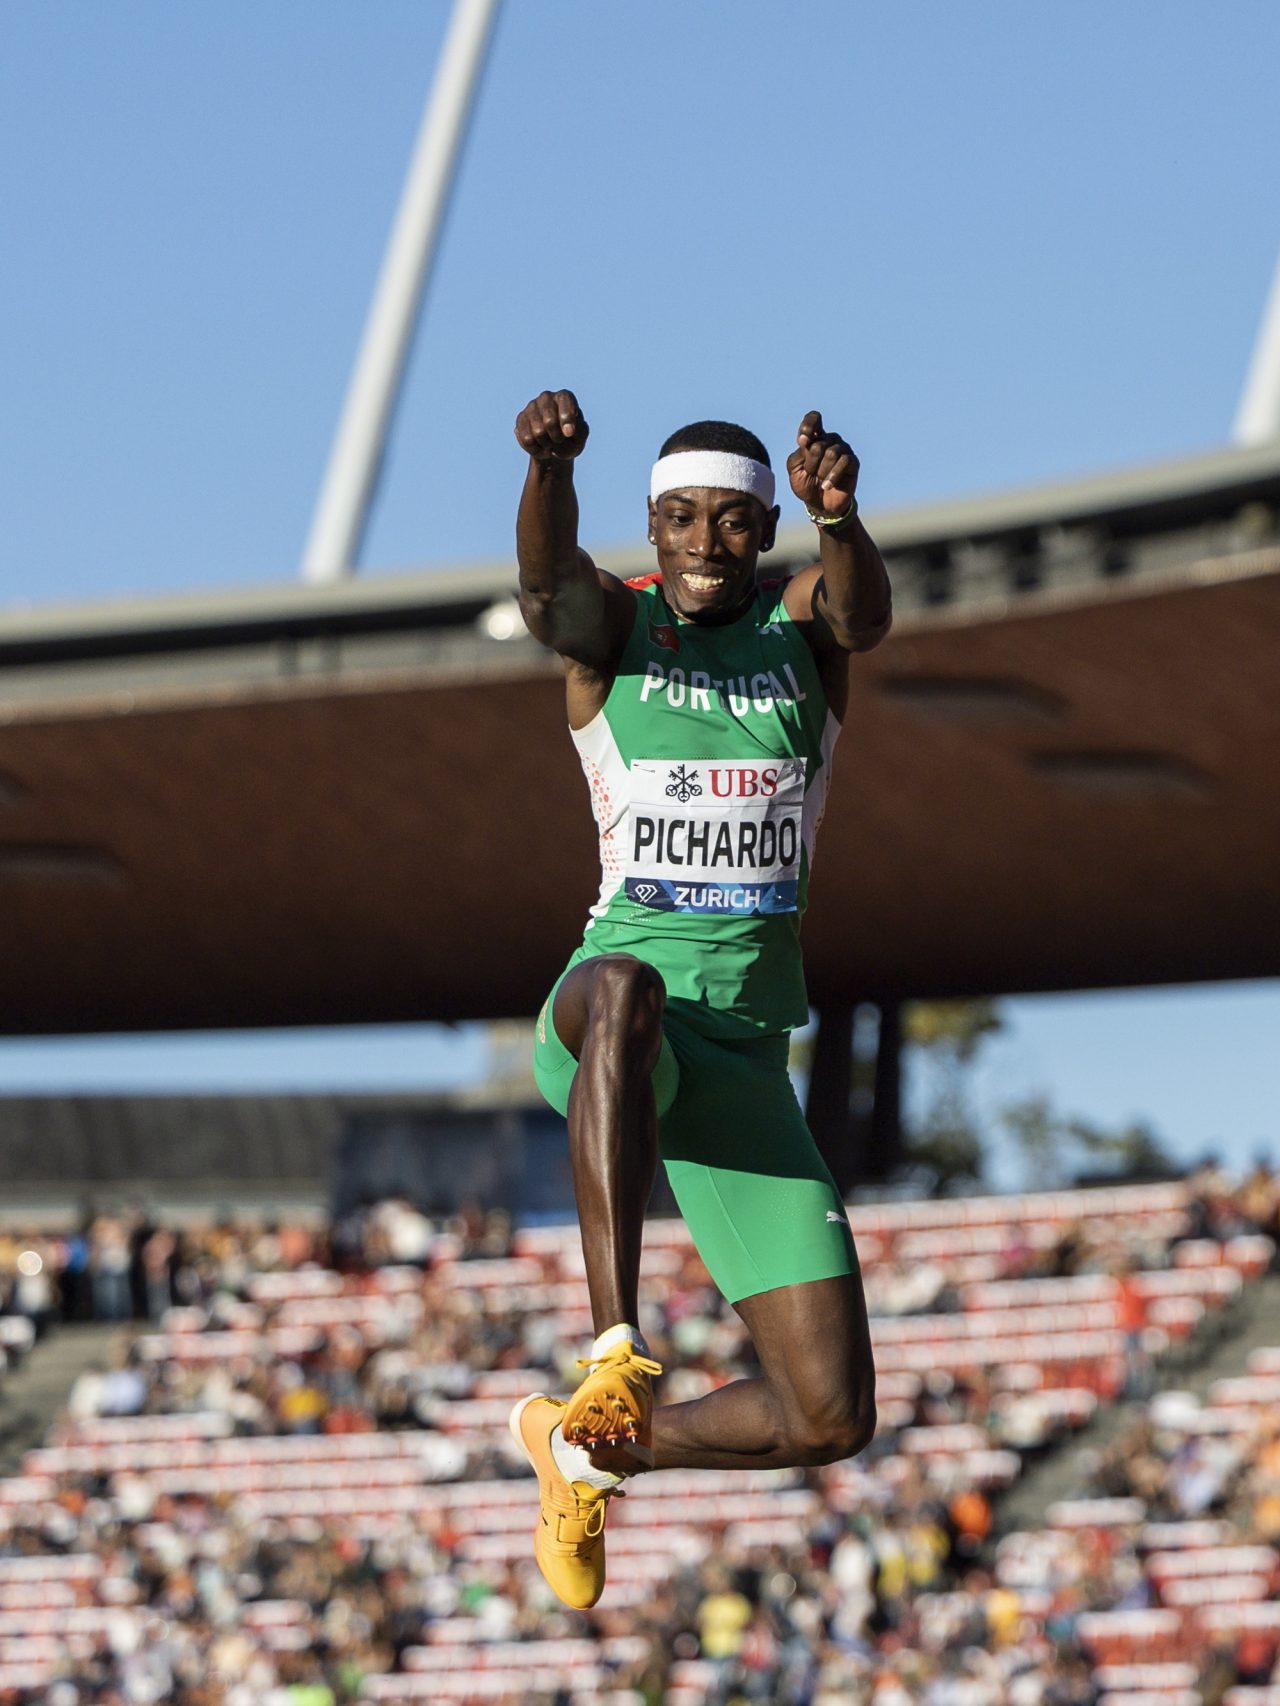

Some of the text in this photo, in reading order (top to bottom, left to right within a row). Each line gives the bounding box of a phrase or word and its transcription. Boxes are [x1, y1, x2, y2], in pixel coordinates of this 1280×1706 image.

[639, 660, 807, 717] PORTUGAL
[708, 768, 779, 798] UBS
[633, 816, 797, 868] PICHARDO
[674, 886, 761, 908] ZURICH
